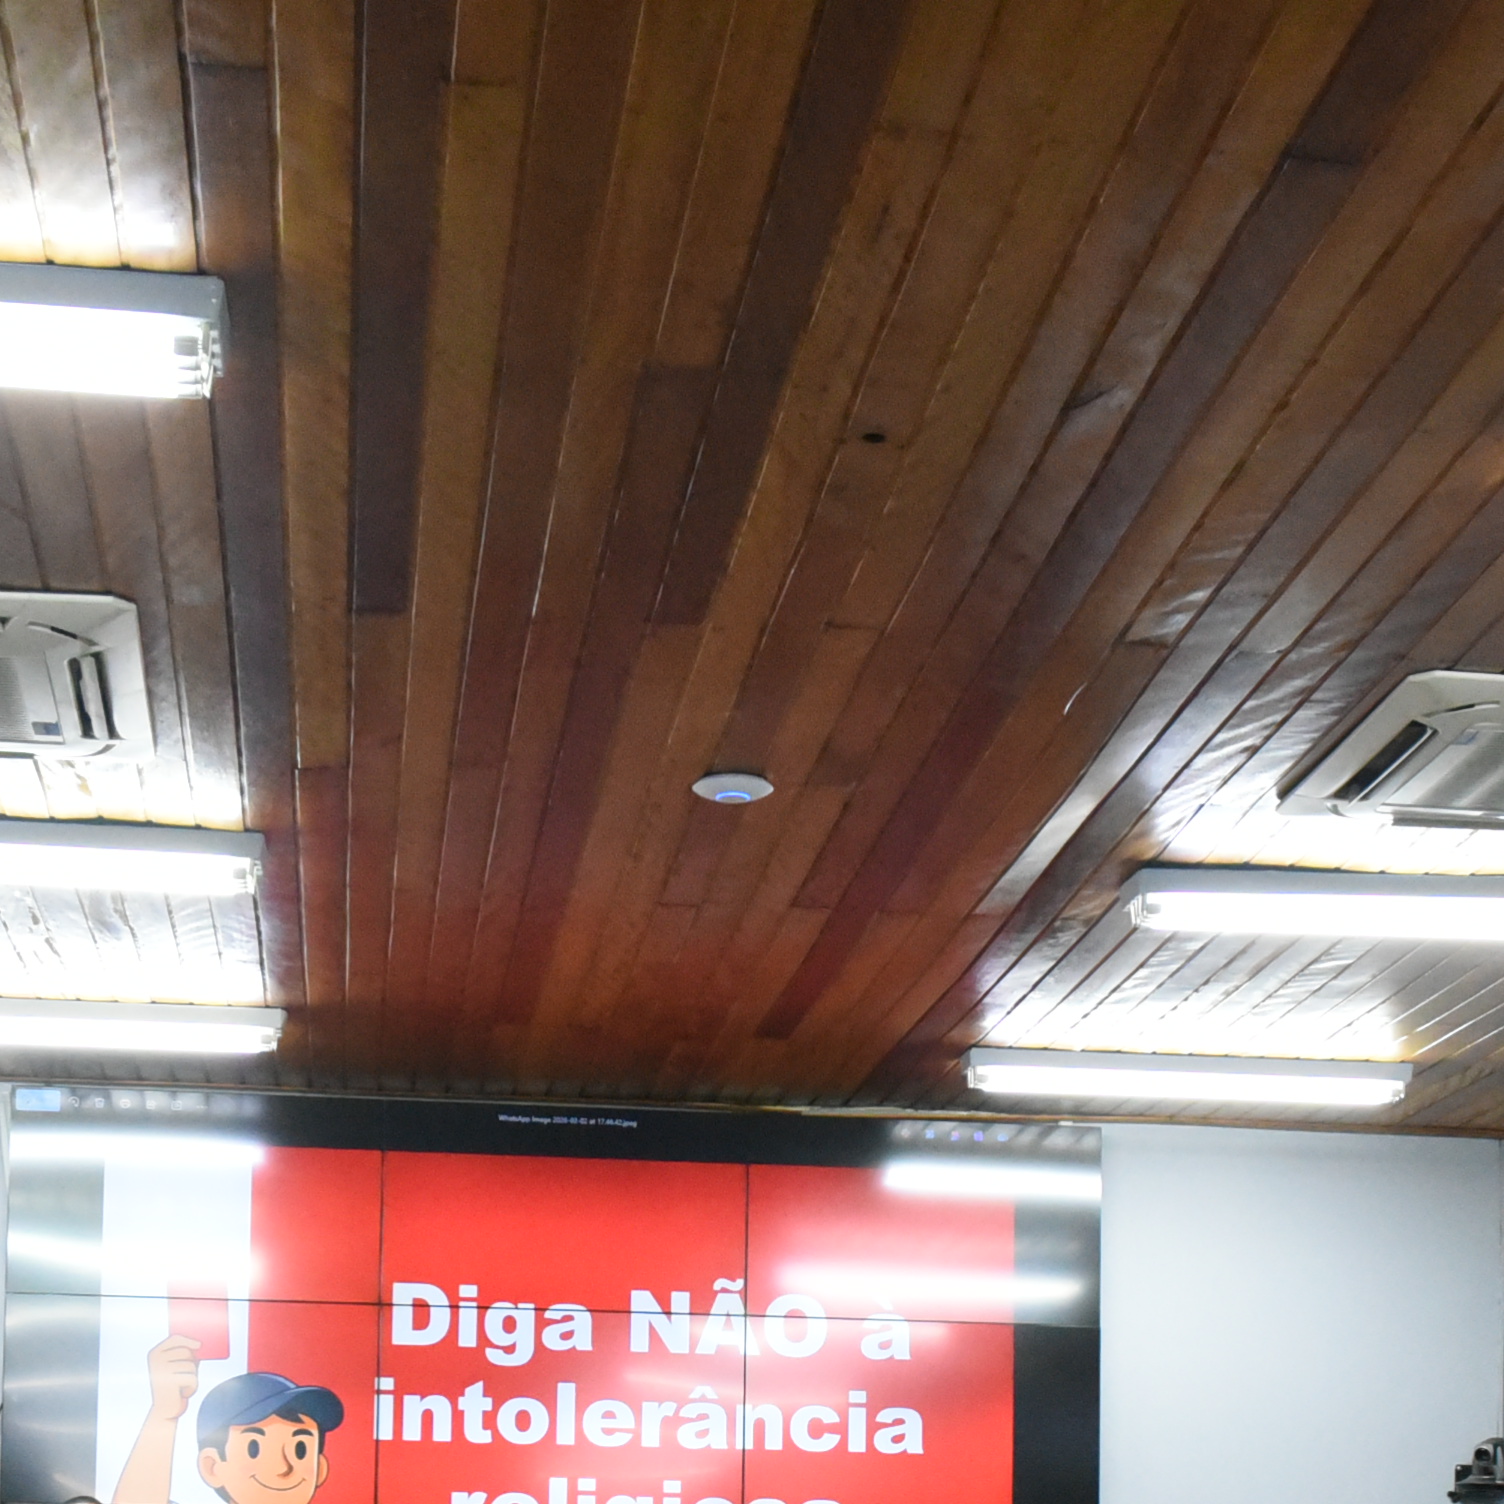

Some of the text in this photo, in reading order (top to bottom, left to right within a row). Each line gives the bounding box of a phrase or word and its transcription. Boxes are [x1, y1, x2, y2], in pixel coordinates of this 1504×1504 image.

[392, 1282, 593, 1367] Diga
[629, 1278, 828, 1358] NÃO
[373, 1376, 924, 1454] intolerância
